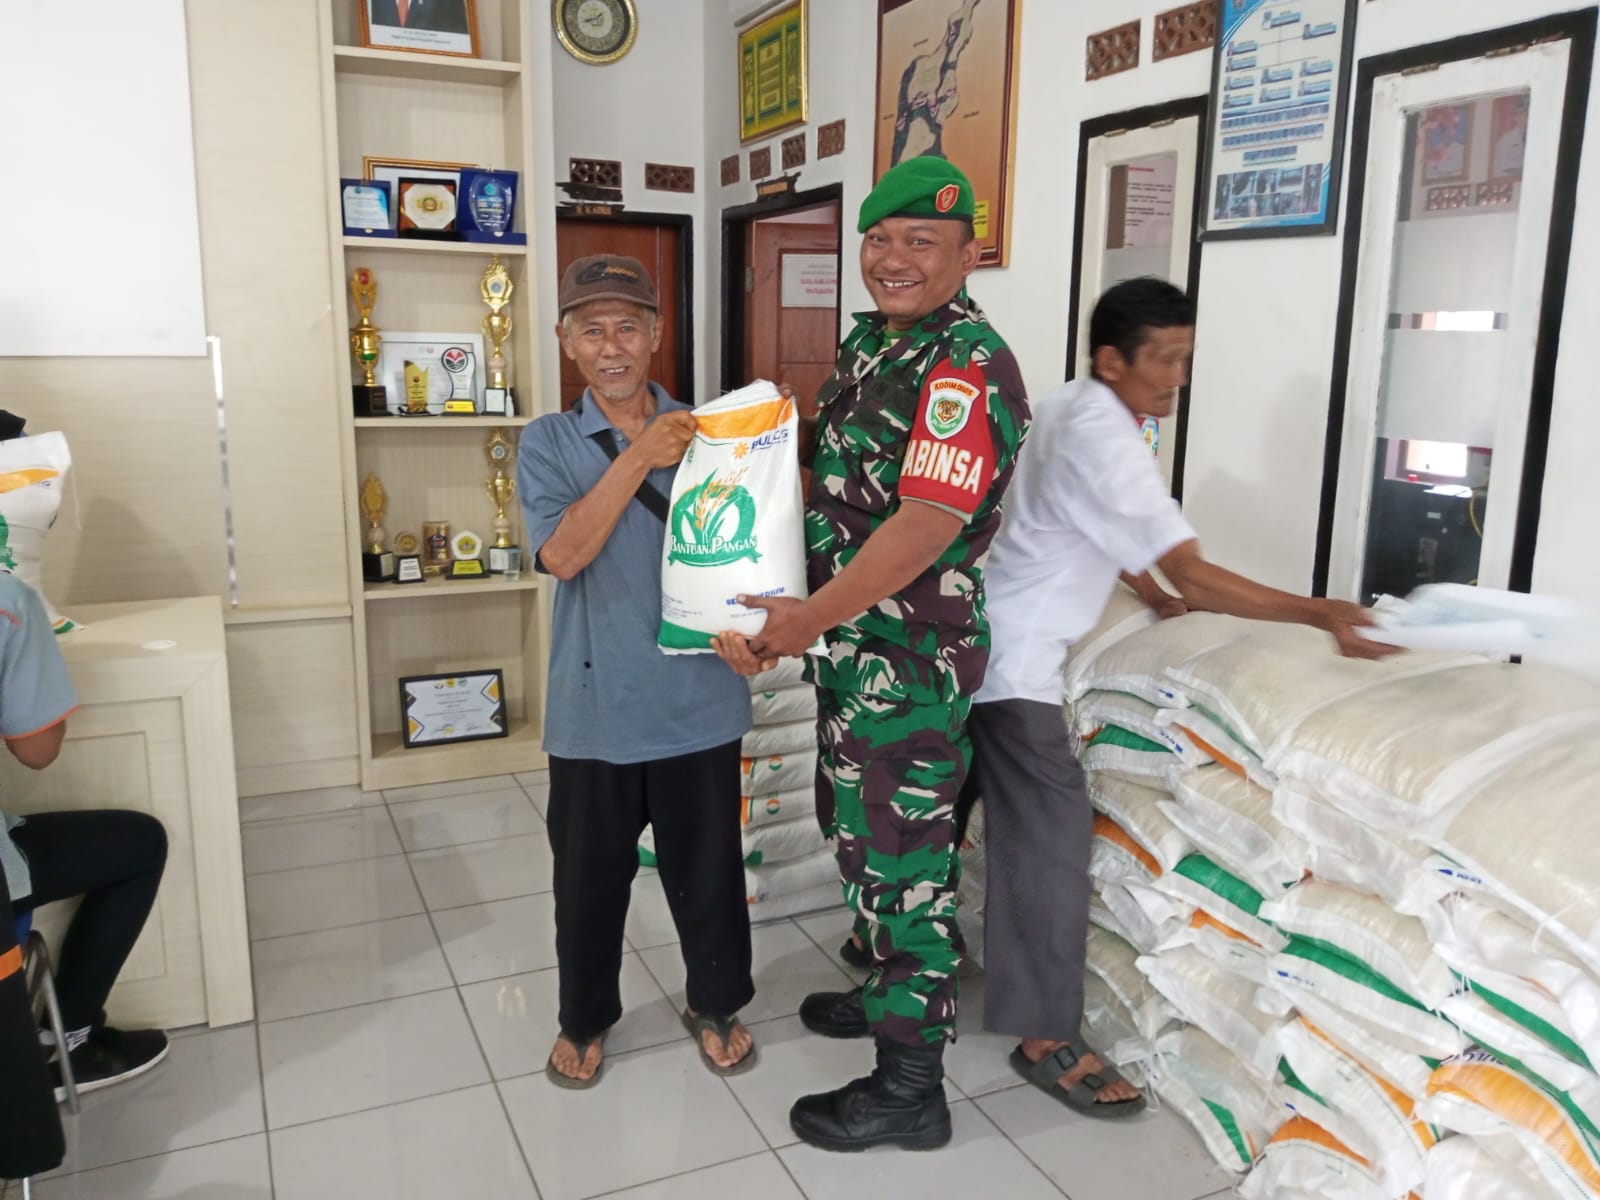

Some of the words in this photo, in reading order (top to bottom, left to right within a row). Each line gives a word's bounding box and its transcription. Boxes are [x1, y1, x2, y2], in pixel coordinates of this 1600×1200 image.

[934, 381, 956, 391] KODIM
[670, 534, 709, 555] BANTUAN
[709, 536, 758, 554] PANGAN
[756, 587, 785, 599] EDIUM
